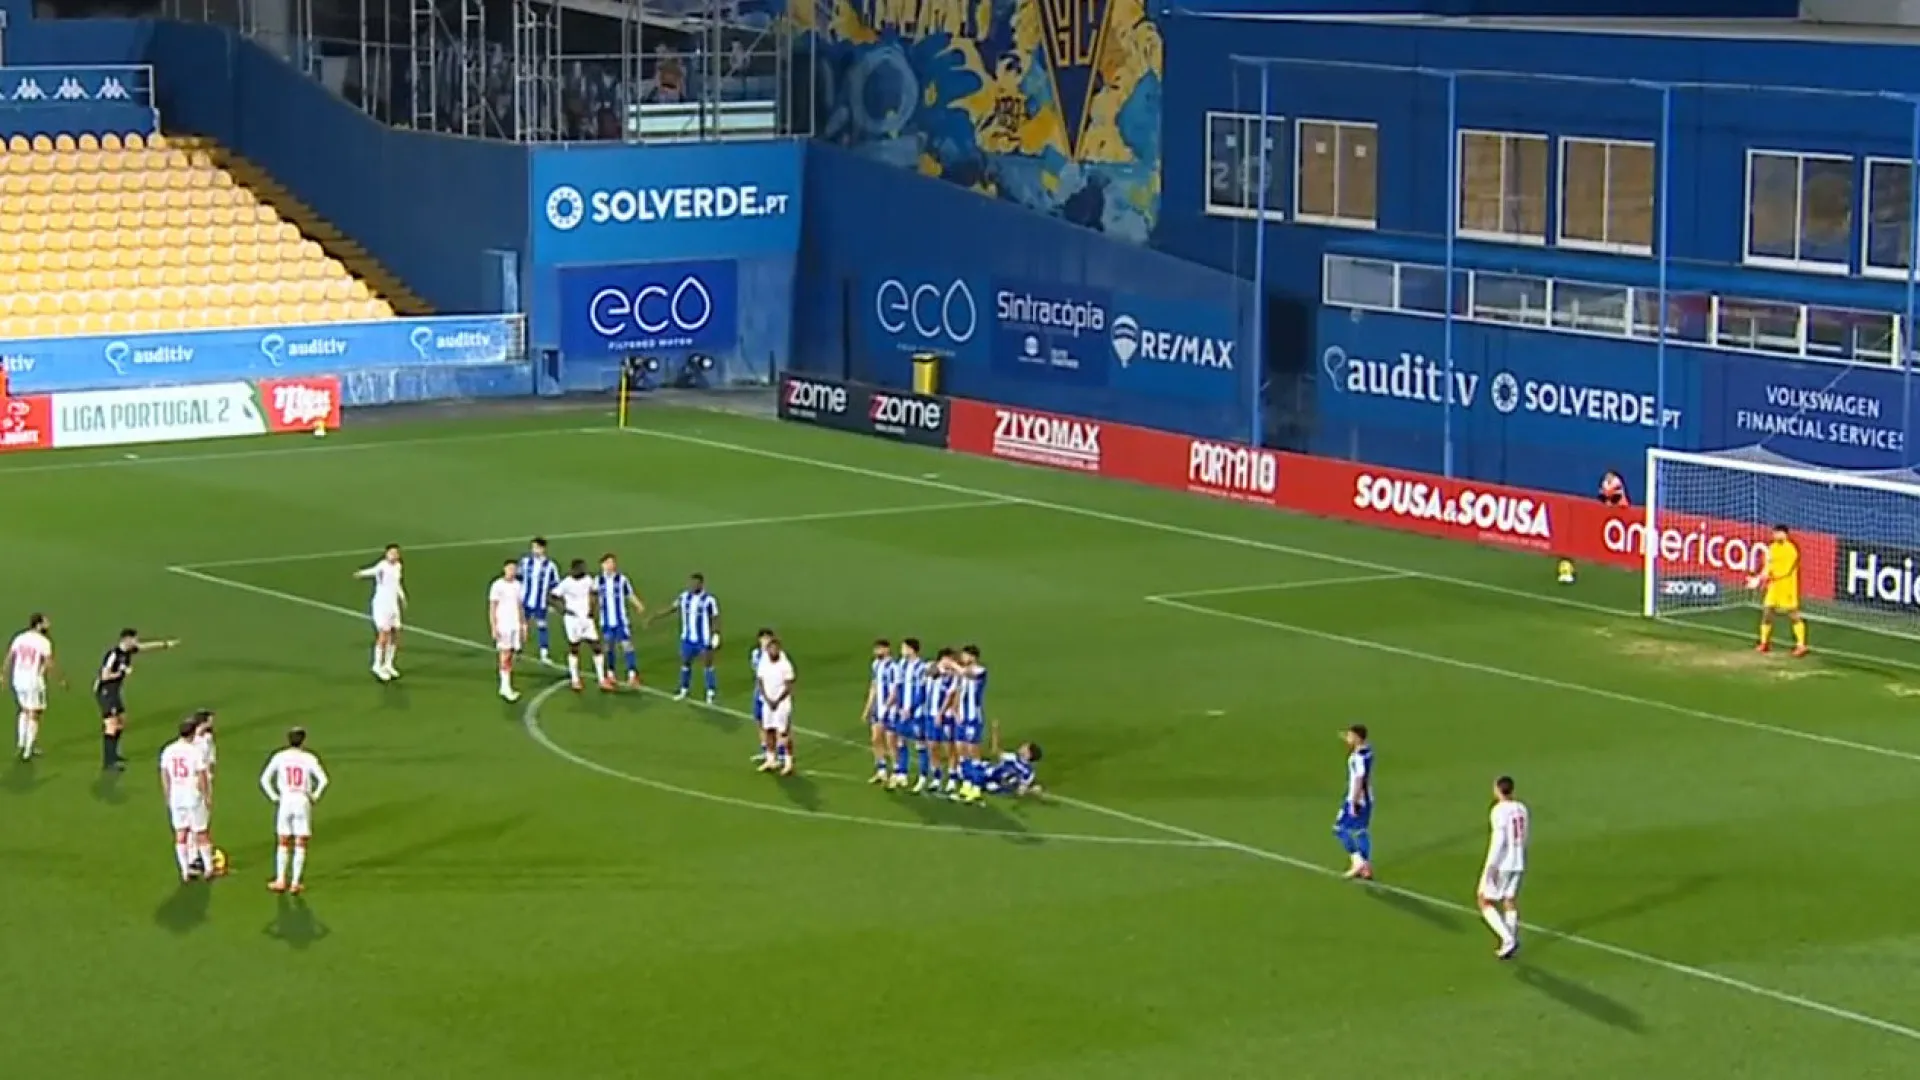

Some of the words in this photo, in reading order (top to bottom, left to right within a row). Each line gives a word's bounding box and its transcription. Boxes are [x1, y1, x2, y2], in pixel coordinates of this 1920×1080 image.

[591, 186, 789, 223] SOLVERDE.PT
[997, 290, 1105, 337] Sintracópia
[133, 345, 194, 365] auditiv
[288, 337, 348, 356] auditiv
[436, 330, 491, 348] auditiv
[1141, 329, 1235, 370] RE/MAX
[2, 354, 36, 373] itiv
[1347, 352, 1480, 407] auditiv
[787, 379, 848, 413] zome
[872, 394, 941, 429] zome
[1766, 385, 1881, 419] VOLKSWAGEN
[61, 404, 106, 433] LIGA
[110, 397, 215, 431] PORTUGAL
[217, 396, 231, 423] 2
[994, 409, 1100, 453] ZIYOMAX
[1736, 410, 1825, 441] FINANCIAL
[1354, 475, 1551, 538] SOUSA&SOUSA
[172, 756, 189, 778] 15
[286, 766, 304, 786] 10
